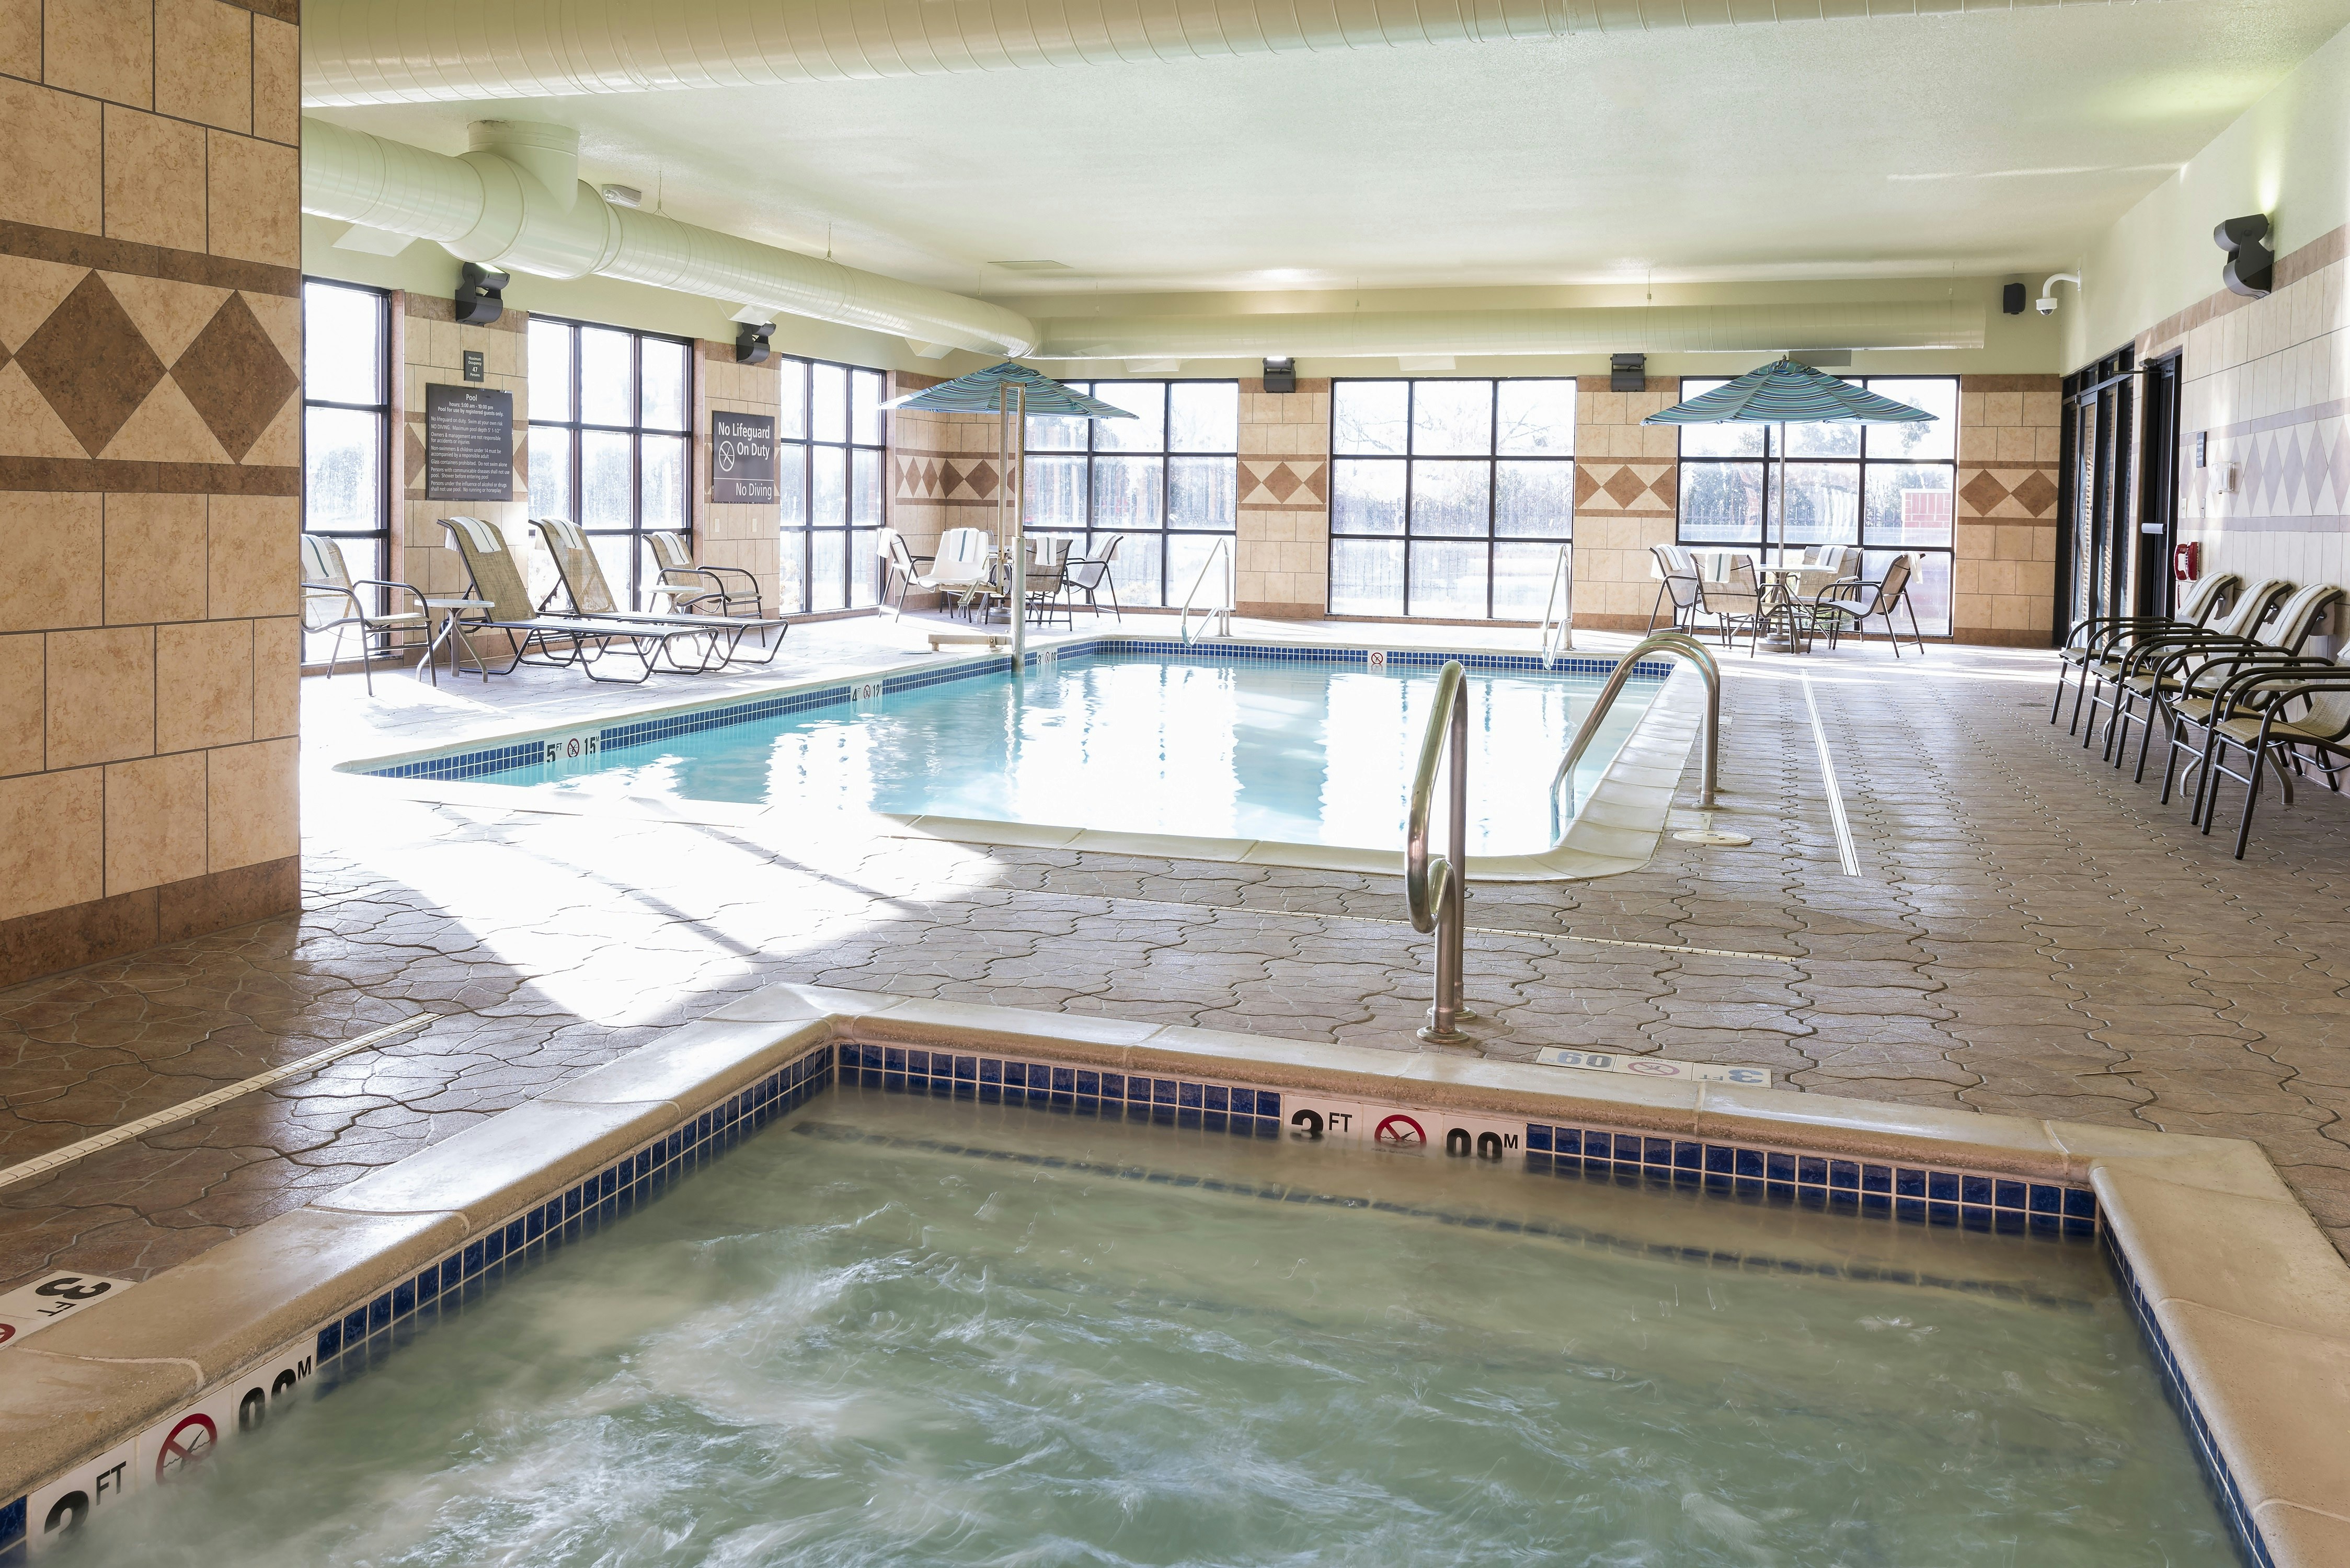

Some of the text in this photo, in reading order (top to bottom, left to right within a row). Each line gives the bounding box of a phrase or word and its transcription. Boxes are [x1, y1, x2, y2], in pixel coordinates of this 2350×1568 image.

[718, 422, 770, 441] No Lifeguard
[737, 442, 770, 460] On Duty
[736, 483, 772, 500] No Diving
[852, 688, 857, 701] 4
[547, 743, 562, 763] 5 FT
[1728, 1069, 1763, 1083] 3
[1329, 1112, 1352, 1132] FT
[1504, 1133, 1518, 1149] M
[36, 1277, 111, 1317] 3 FT
[298, 1355, 312, 1380] M
[96, 1460, 127, 1506] FT
